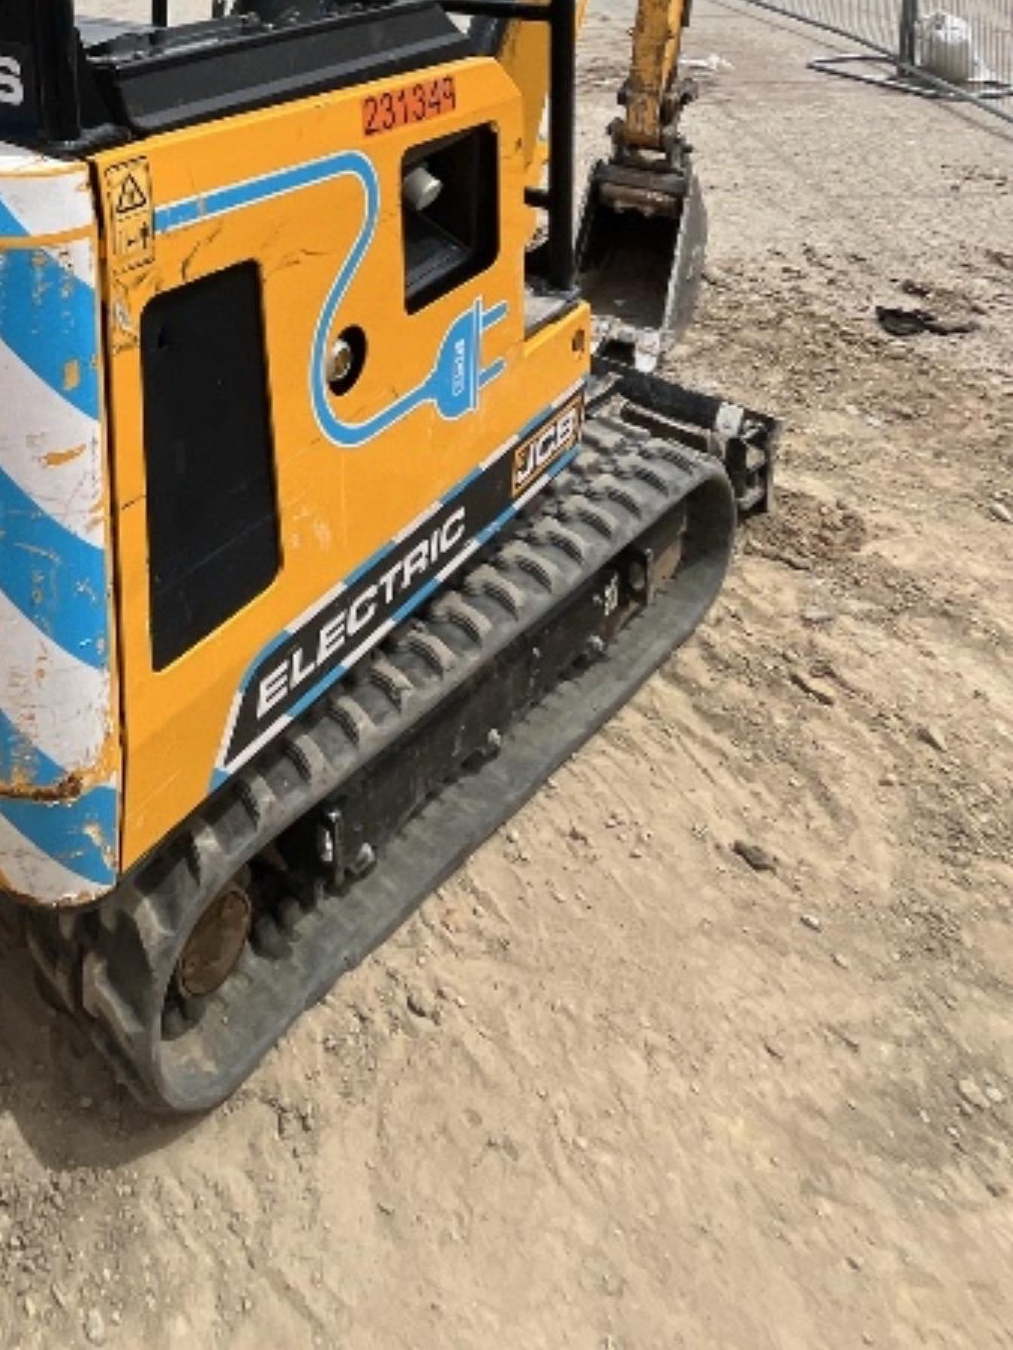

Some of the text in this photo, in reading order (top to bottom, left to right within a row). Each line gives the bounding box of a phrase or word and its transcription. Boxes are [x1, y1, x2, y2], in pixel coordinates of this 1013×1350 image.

[364, 76, 455, 136] 231349
[517, 409, 576, 483] JCB
[256, 507, 466, 719] ELECTRIC
